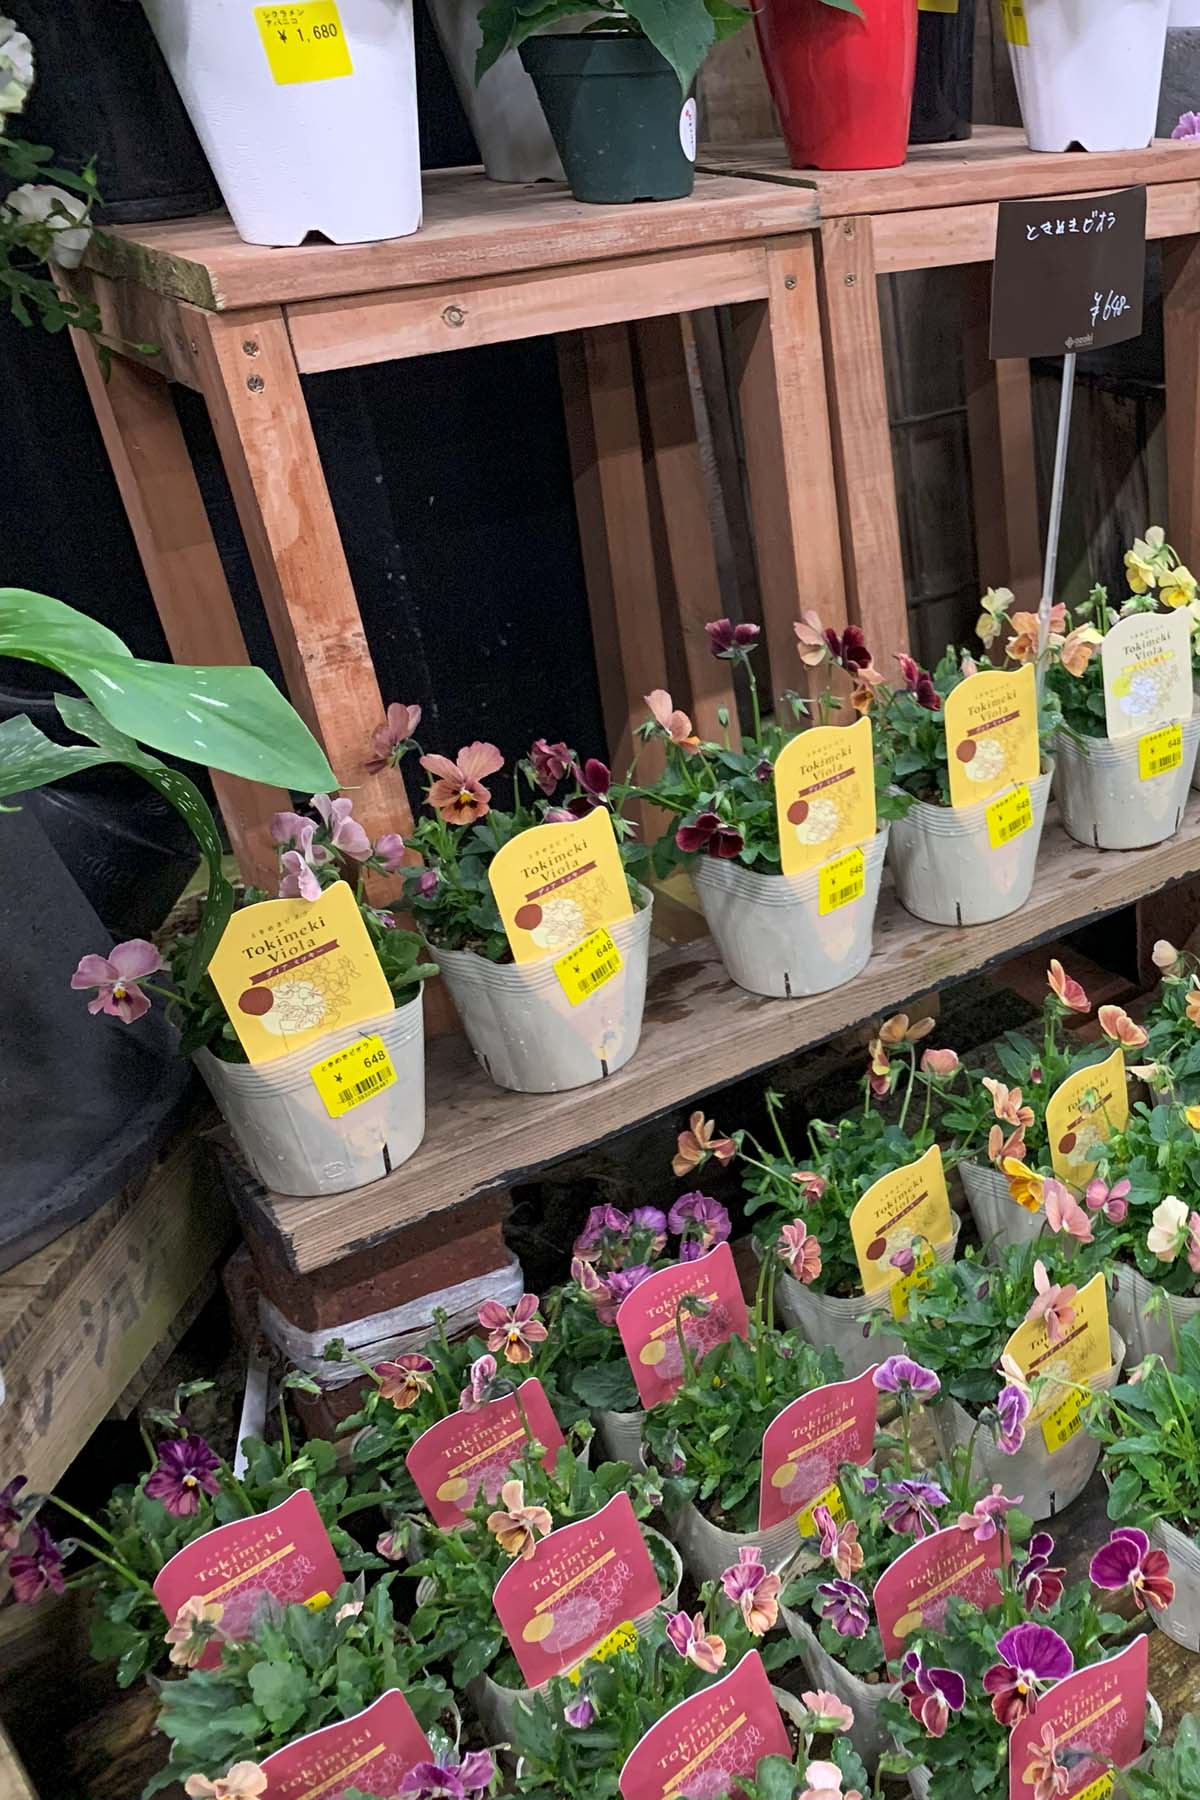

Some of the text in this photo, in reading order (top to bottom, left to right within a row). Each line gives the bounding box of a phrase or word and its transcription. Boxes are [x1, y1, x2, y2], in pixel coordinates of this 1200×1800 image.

[1026, 210, 1116, 241] ときめきビオラ
[521, 839, 589, 880] Tokimeki
[540, 859, 580, 883] Viola
[242, 916, 326, 960] Tokimeki
[267, 938, 316, 963] Viola
[596, 940, 614, 958] 648
[363, 1049, 386, 1069] 648
[442, 1409, 517, 1459] Tokimeki
[792, 1398, 855, 1439] Tokimeki
[195, 1525, 283, 1582] Tokimeki
[221, 1548, 272, 1580] Viola
[529, 1530, 606, 1592] Tokimeki
[552, 1554, 596, 1587] Viola
[657, 1695, 736, 1770] Tokimeki
